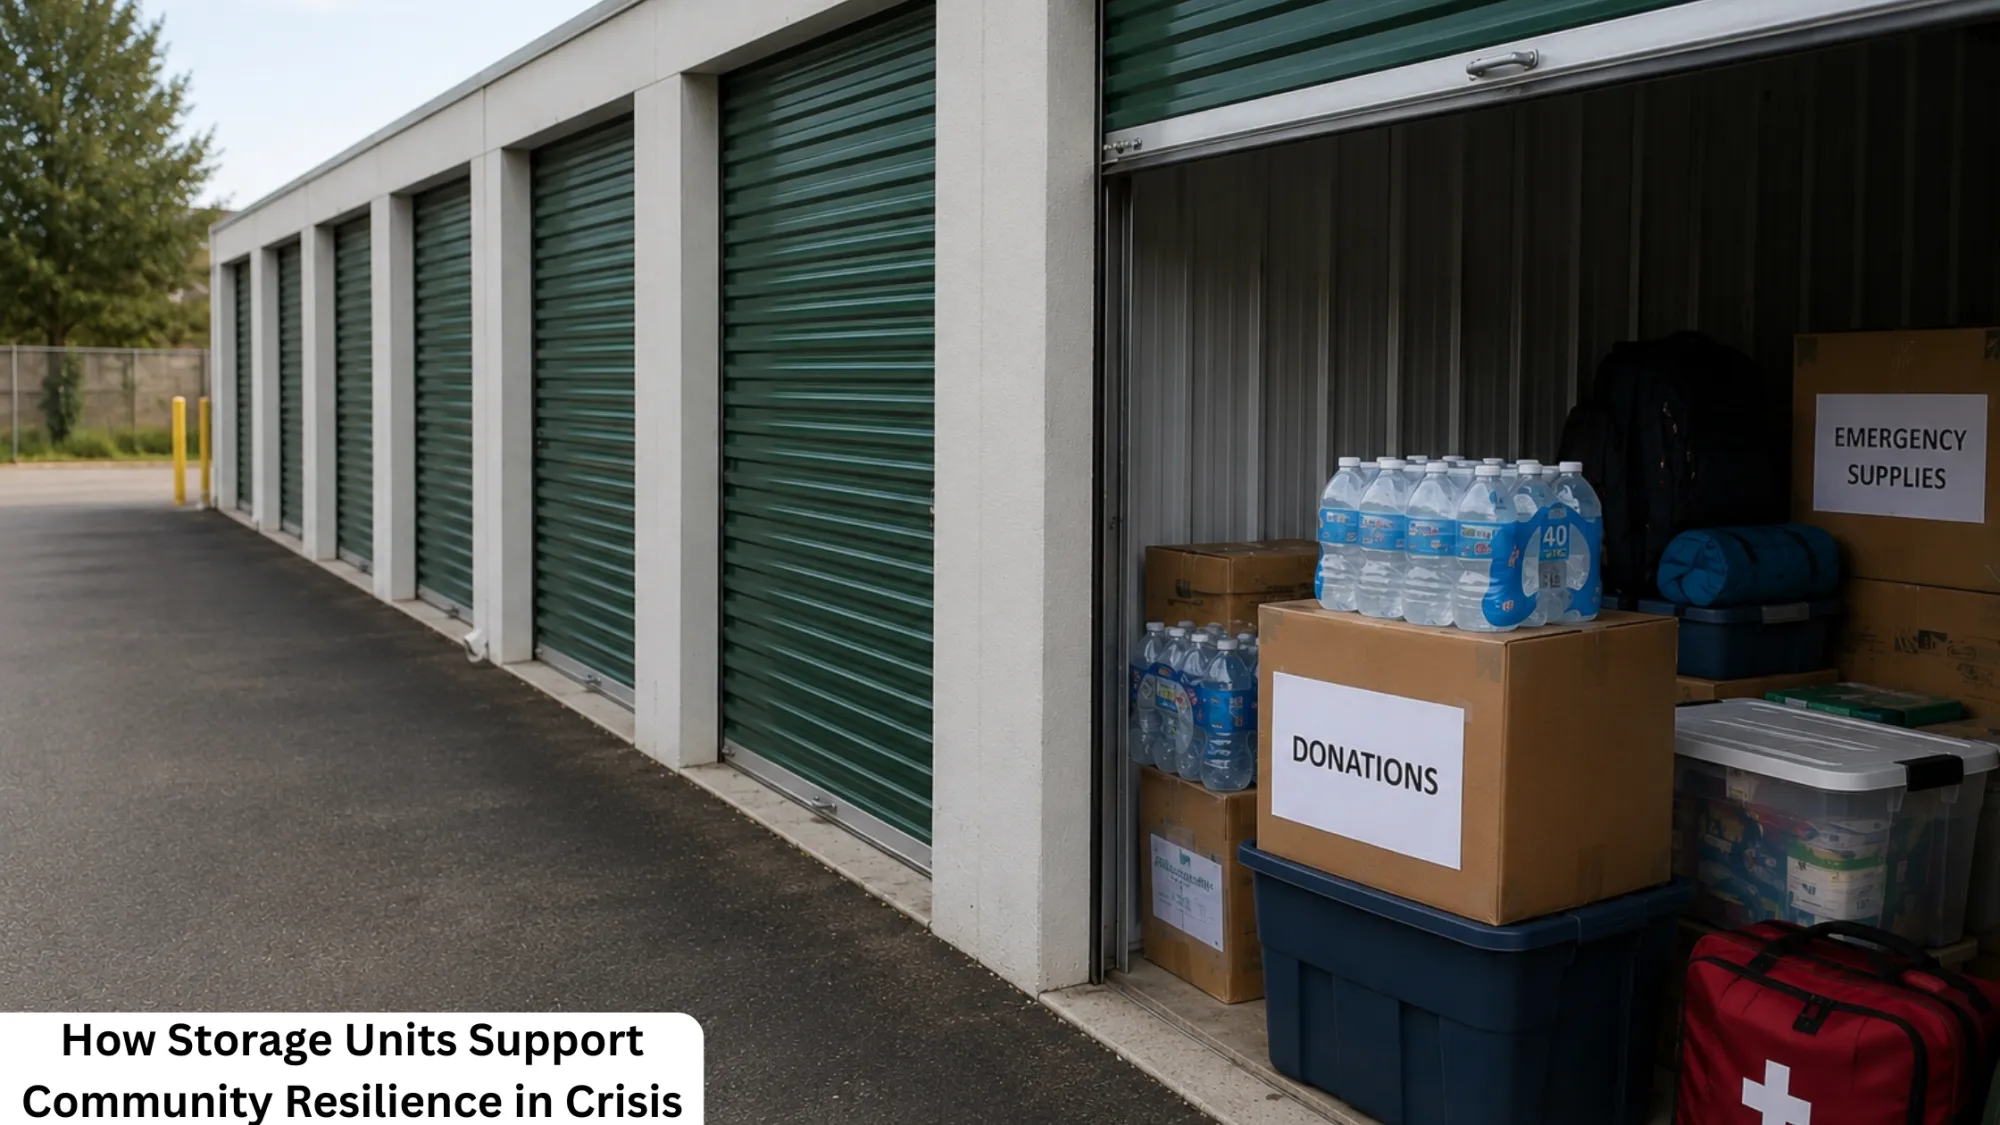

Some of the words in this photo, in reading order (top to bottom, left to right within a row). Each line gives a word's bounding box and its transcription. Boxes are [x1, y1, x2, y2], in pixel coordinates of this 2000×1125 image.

[1834, 426, 1968, 452] EMERGENCY
[1847, 463, 1947, 490] SUPPLIES
[1542, 524, 1568, 547] 40
[1292, 734, 1439, 796] DONATIONS
